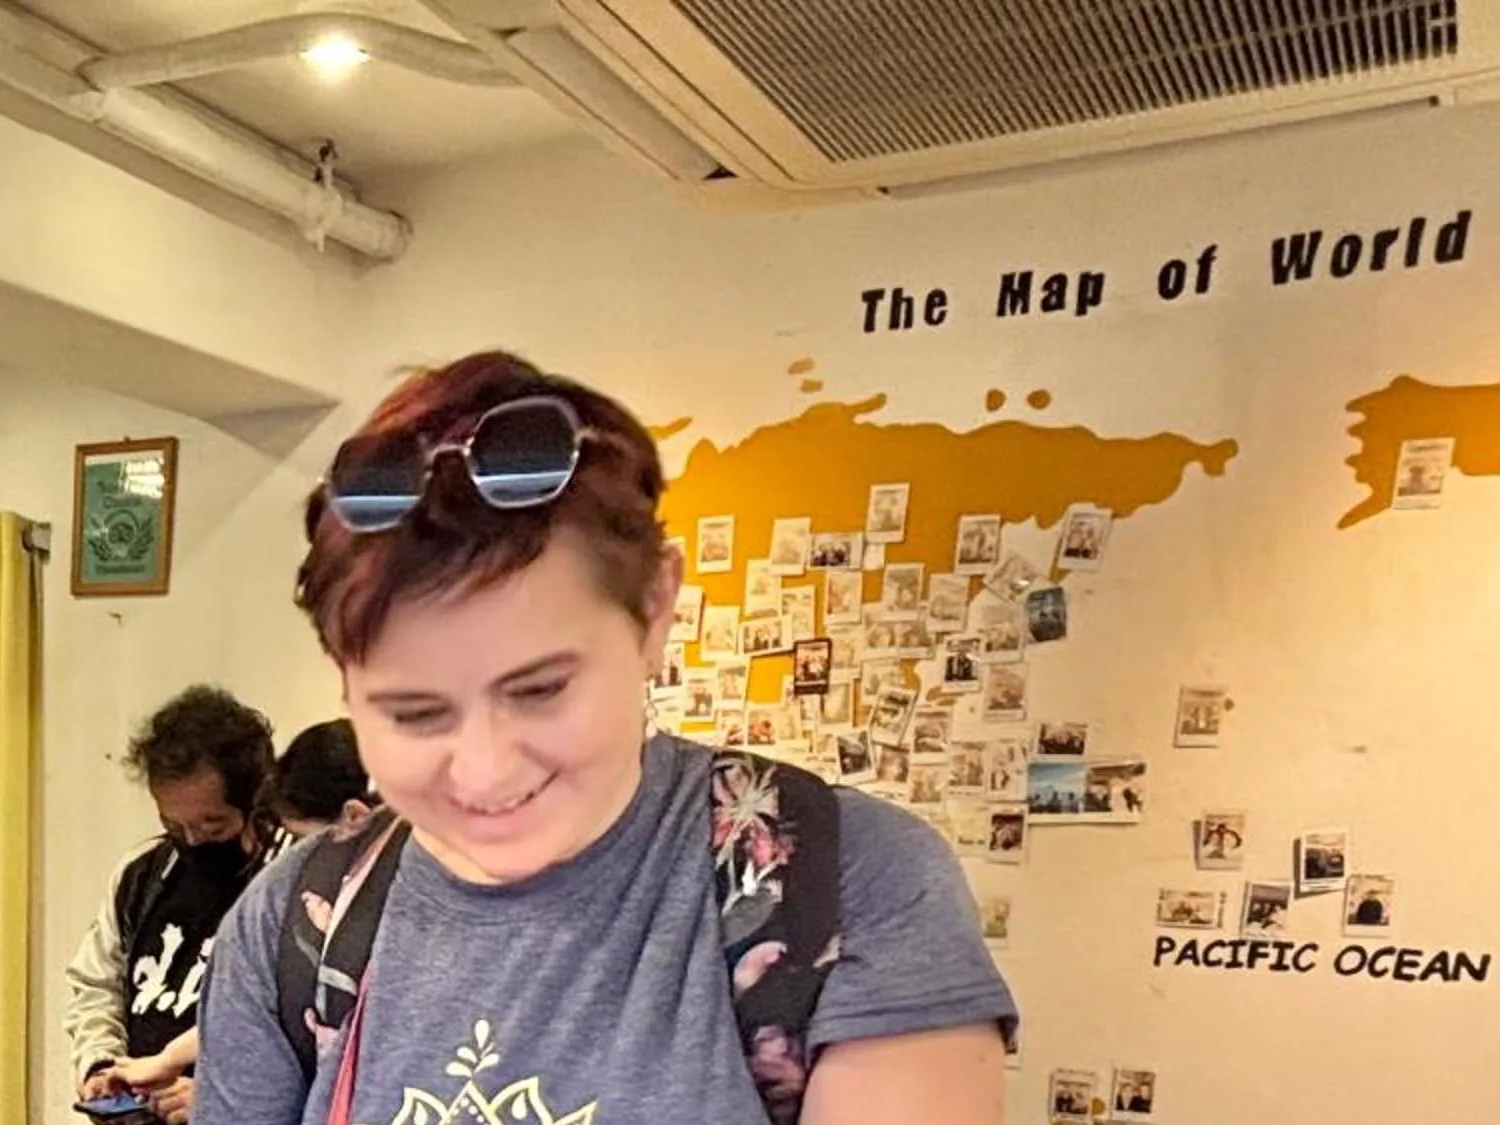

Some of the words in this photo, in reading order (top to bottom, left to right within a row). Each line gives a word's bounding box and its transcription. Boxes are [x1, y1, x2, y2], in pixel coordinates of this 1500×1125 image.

[861, 287, 949, 334] The
[996, 270, 1106, 317] Map
[1157, 244, 1219, 301] of
[1271, 210, 1473, 286] World
[1153, 936, 1319, 973] PACIFIC
[1333, 944, 1492, 982] OCEAN
